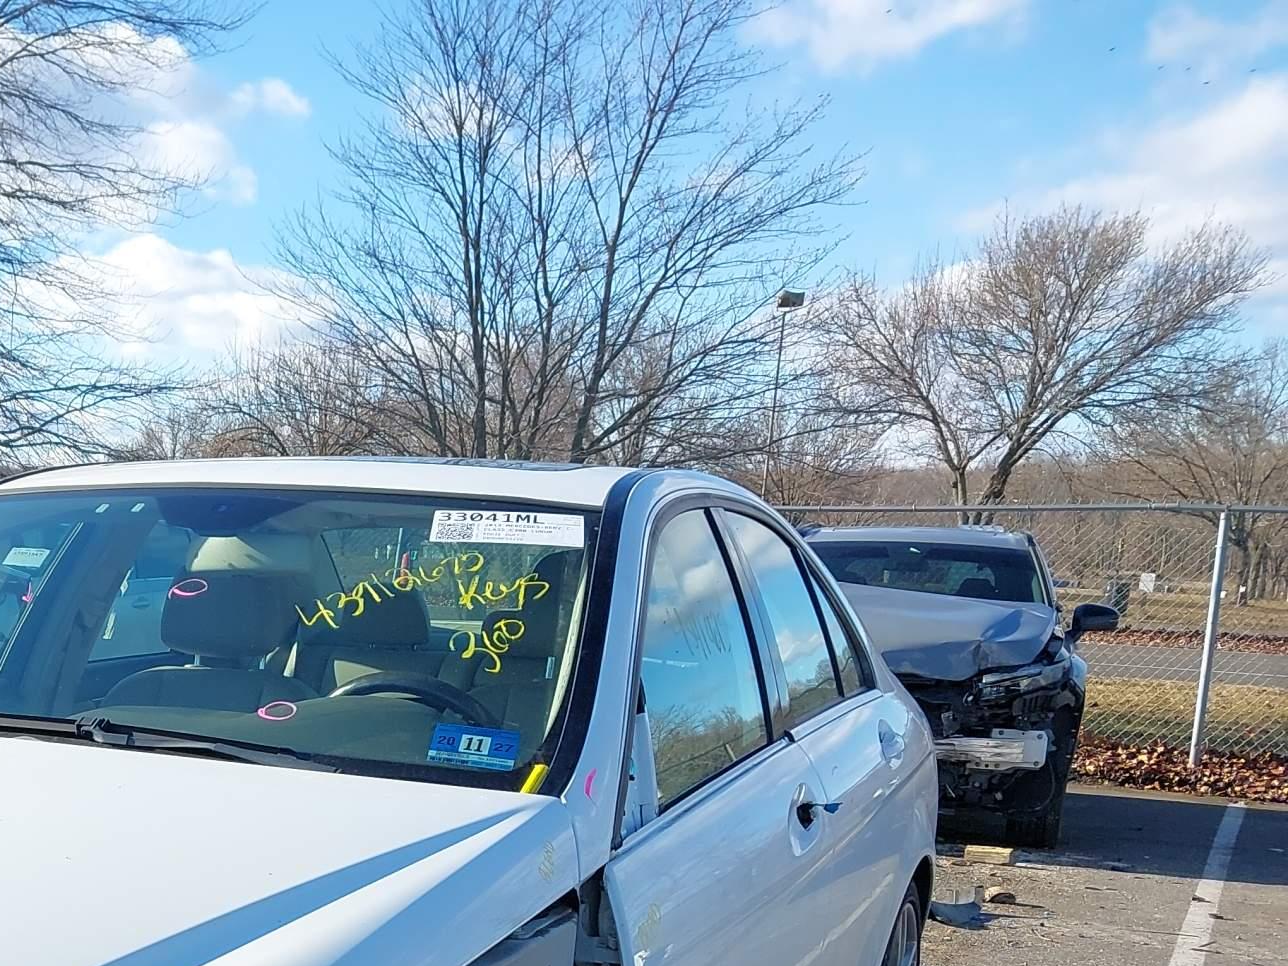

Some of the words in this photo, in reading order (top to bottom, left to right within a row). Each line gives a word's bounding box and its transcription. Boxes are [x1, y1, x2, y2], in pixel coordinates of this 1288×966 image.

[438, 512, 545, 524] 33041ML
[437, 735, 457, 746] 20
[463, 737, 484, 753] 11
[494, 743, 514, 753] 27
